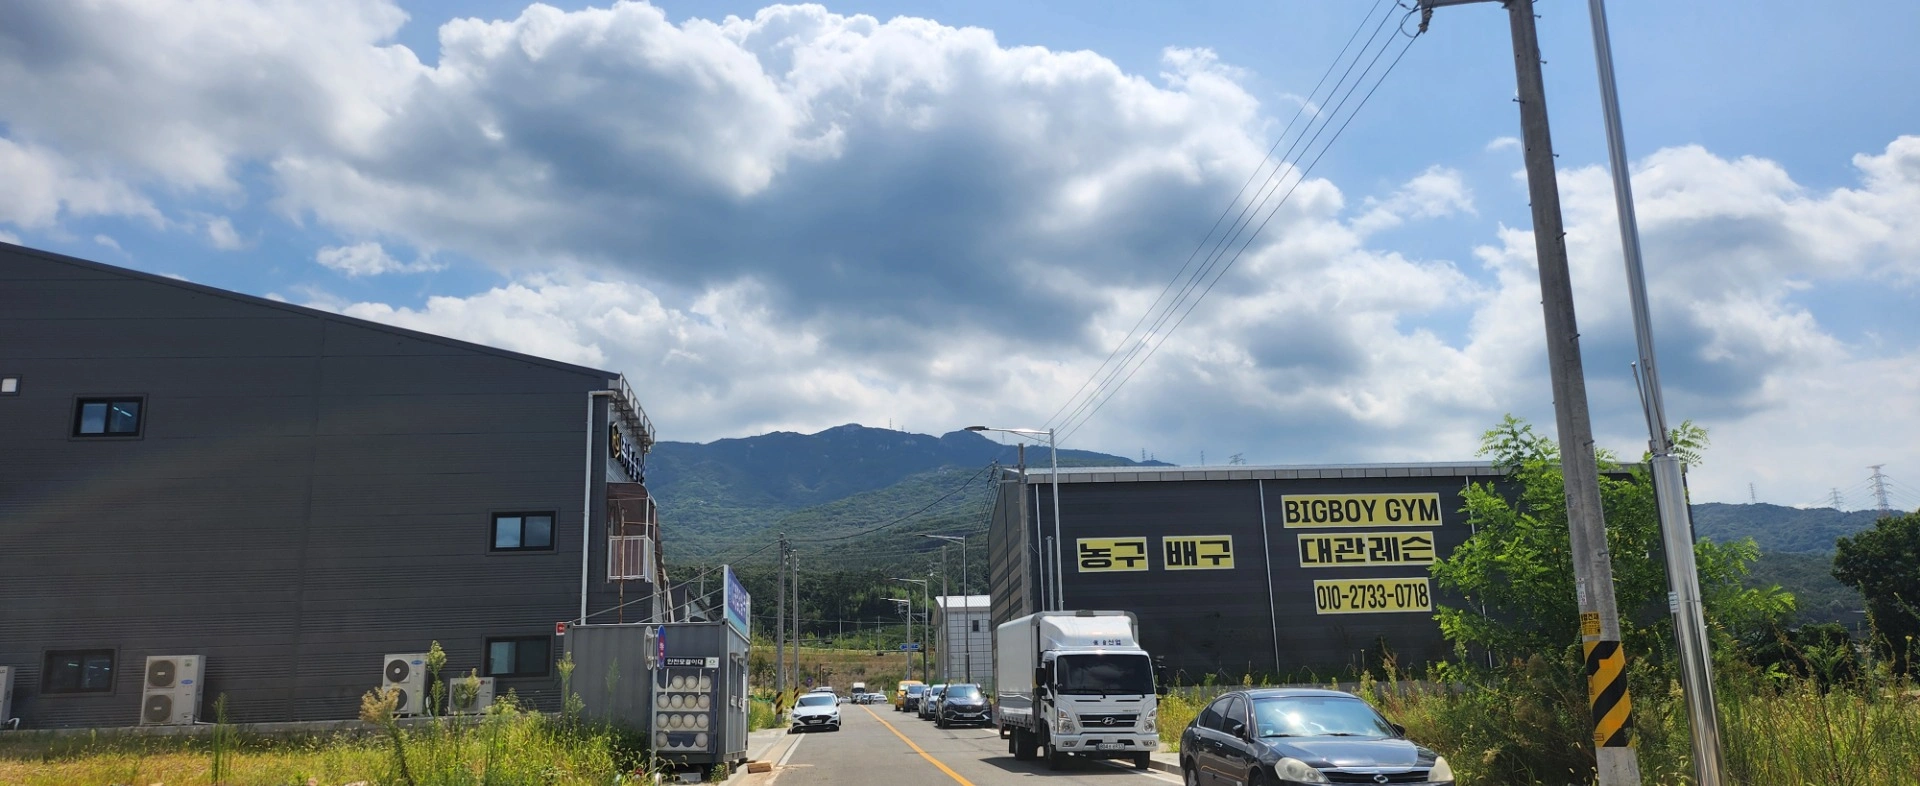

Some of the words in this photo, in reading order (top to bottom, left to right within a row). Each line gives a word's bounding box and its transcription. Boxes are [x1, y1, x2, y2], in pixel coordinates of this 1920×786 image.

[1284, 498, 1377, 524] BIGBOY
[1385, 497, 1439, 522] GYM
[1079, 541, 1145, 569] 농구
[1166, 539, 1232, 567] 배구
[1316, 582, 1429, 610] 010-2733-0718
